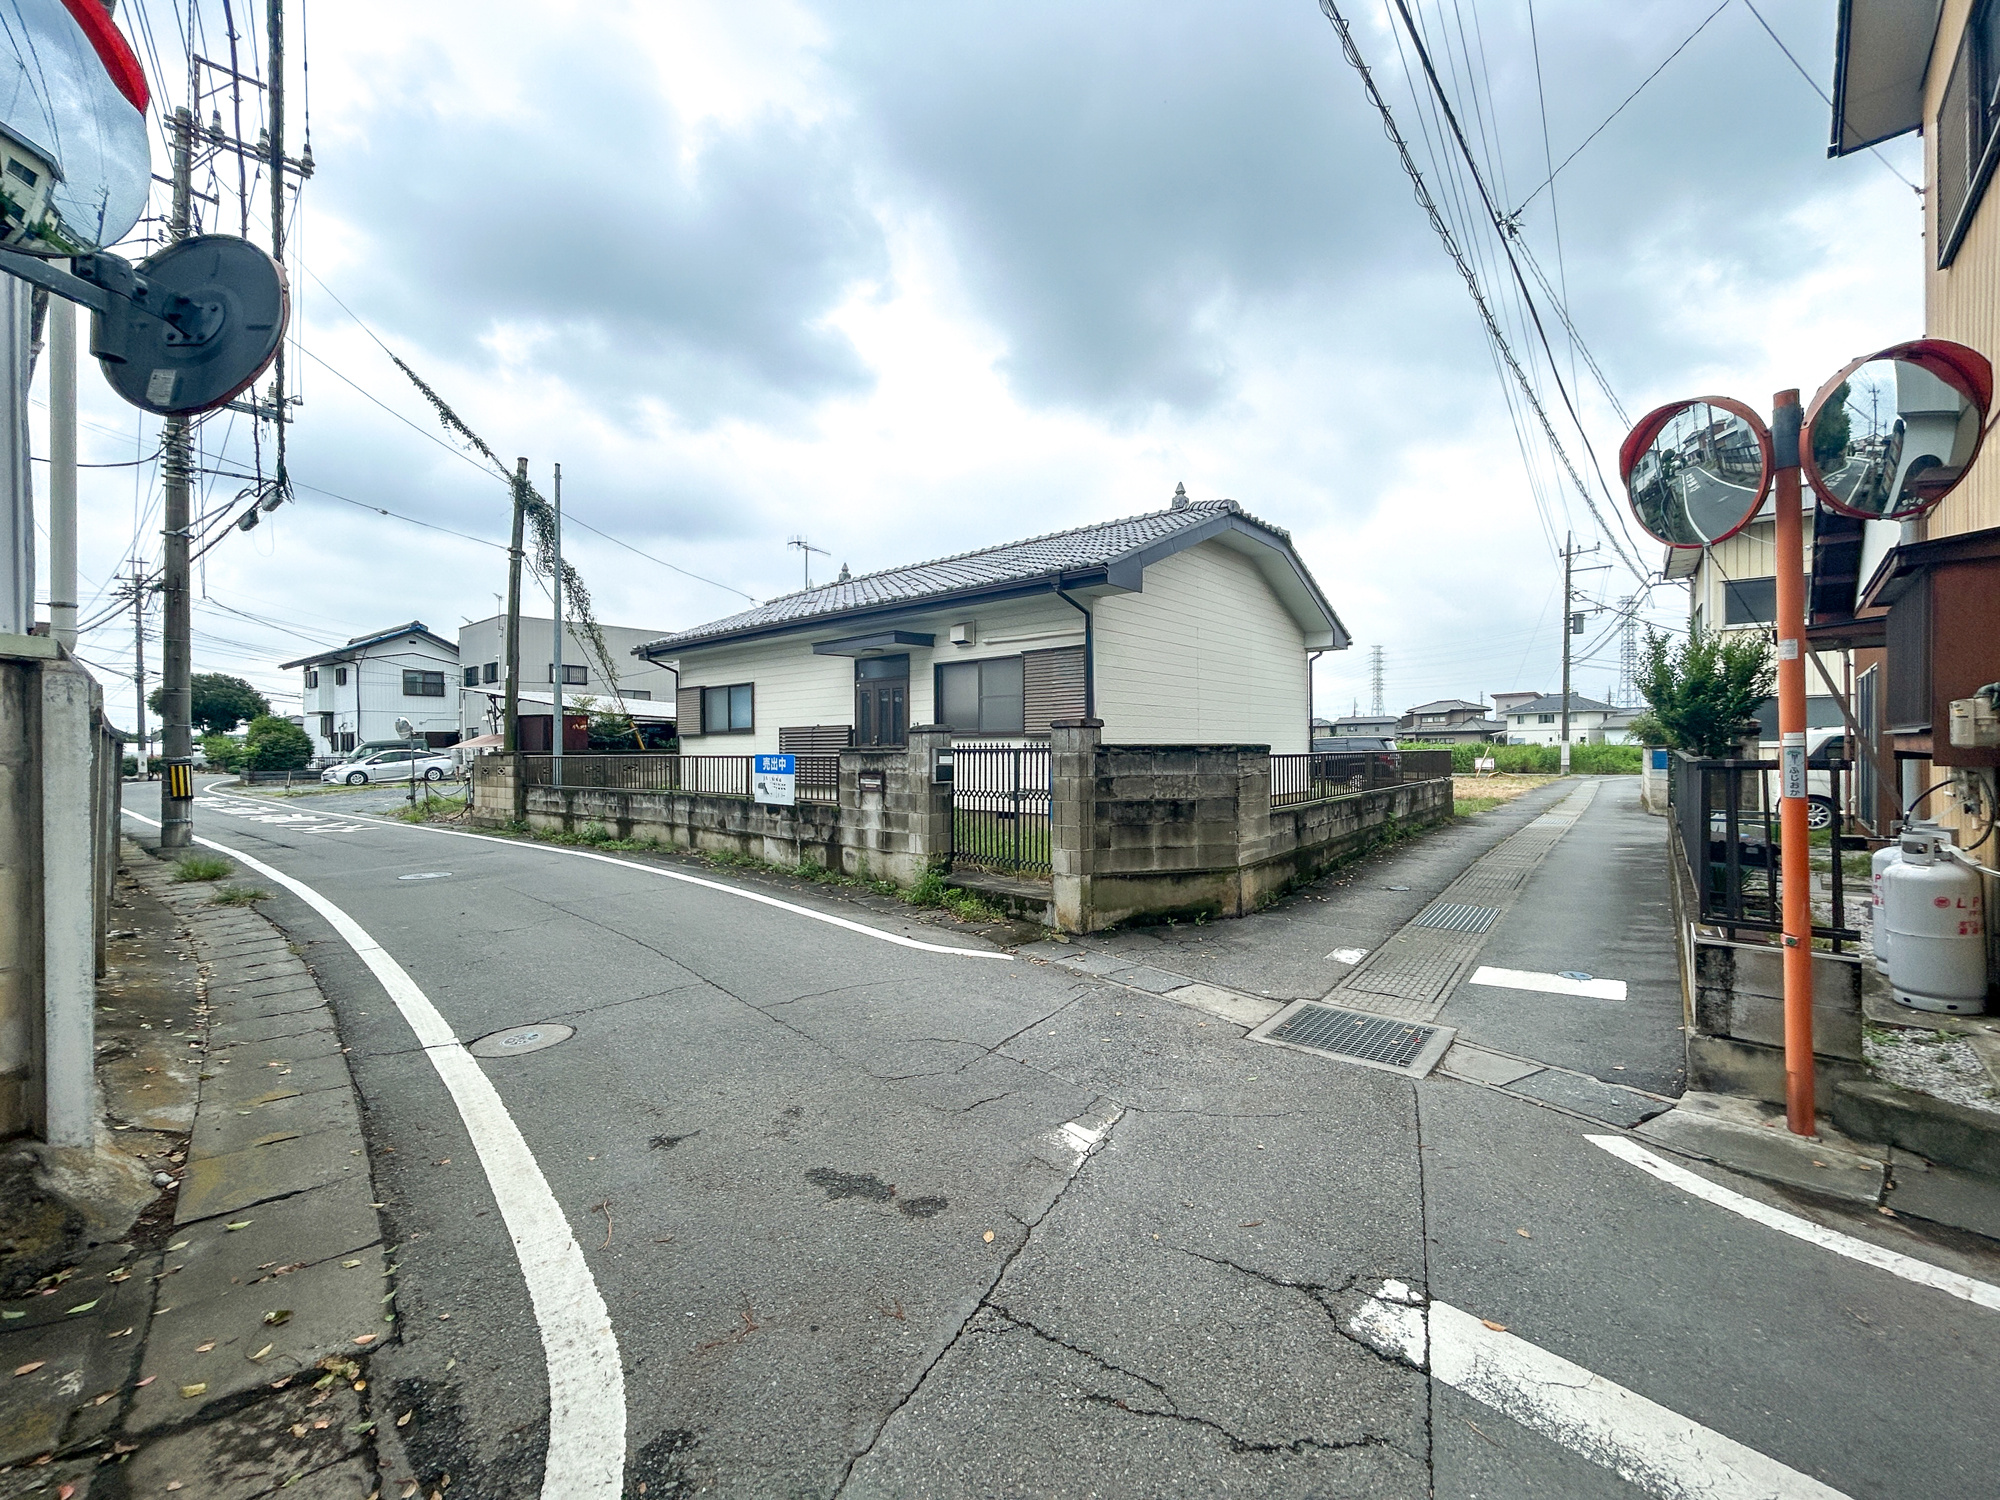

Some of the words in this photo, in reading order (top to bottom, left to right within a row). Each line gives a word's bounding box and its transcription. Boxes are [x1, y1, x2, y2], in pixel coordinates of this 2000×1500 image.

[762, 757, 787, 771] 売出中
[1789, 766, 1800, 796] ふじおか
